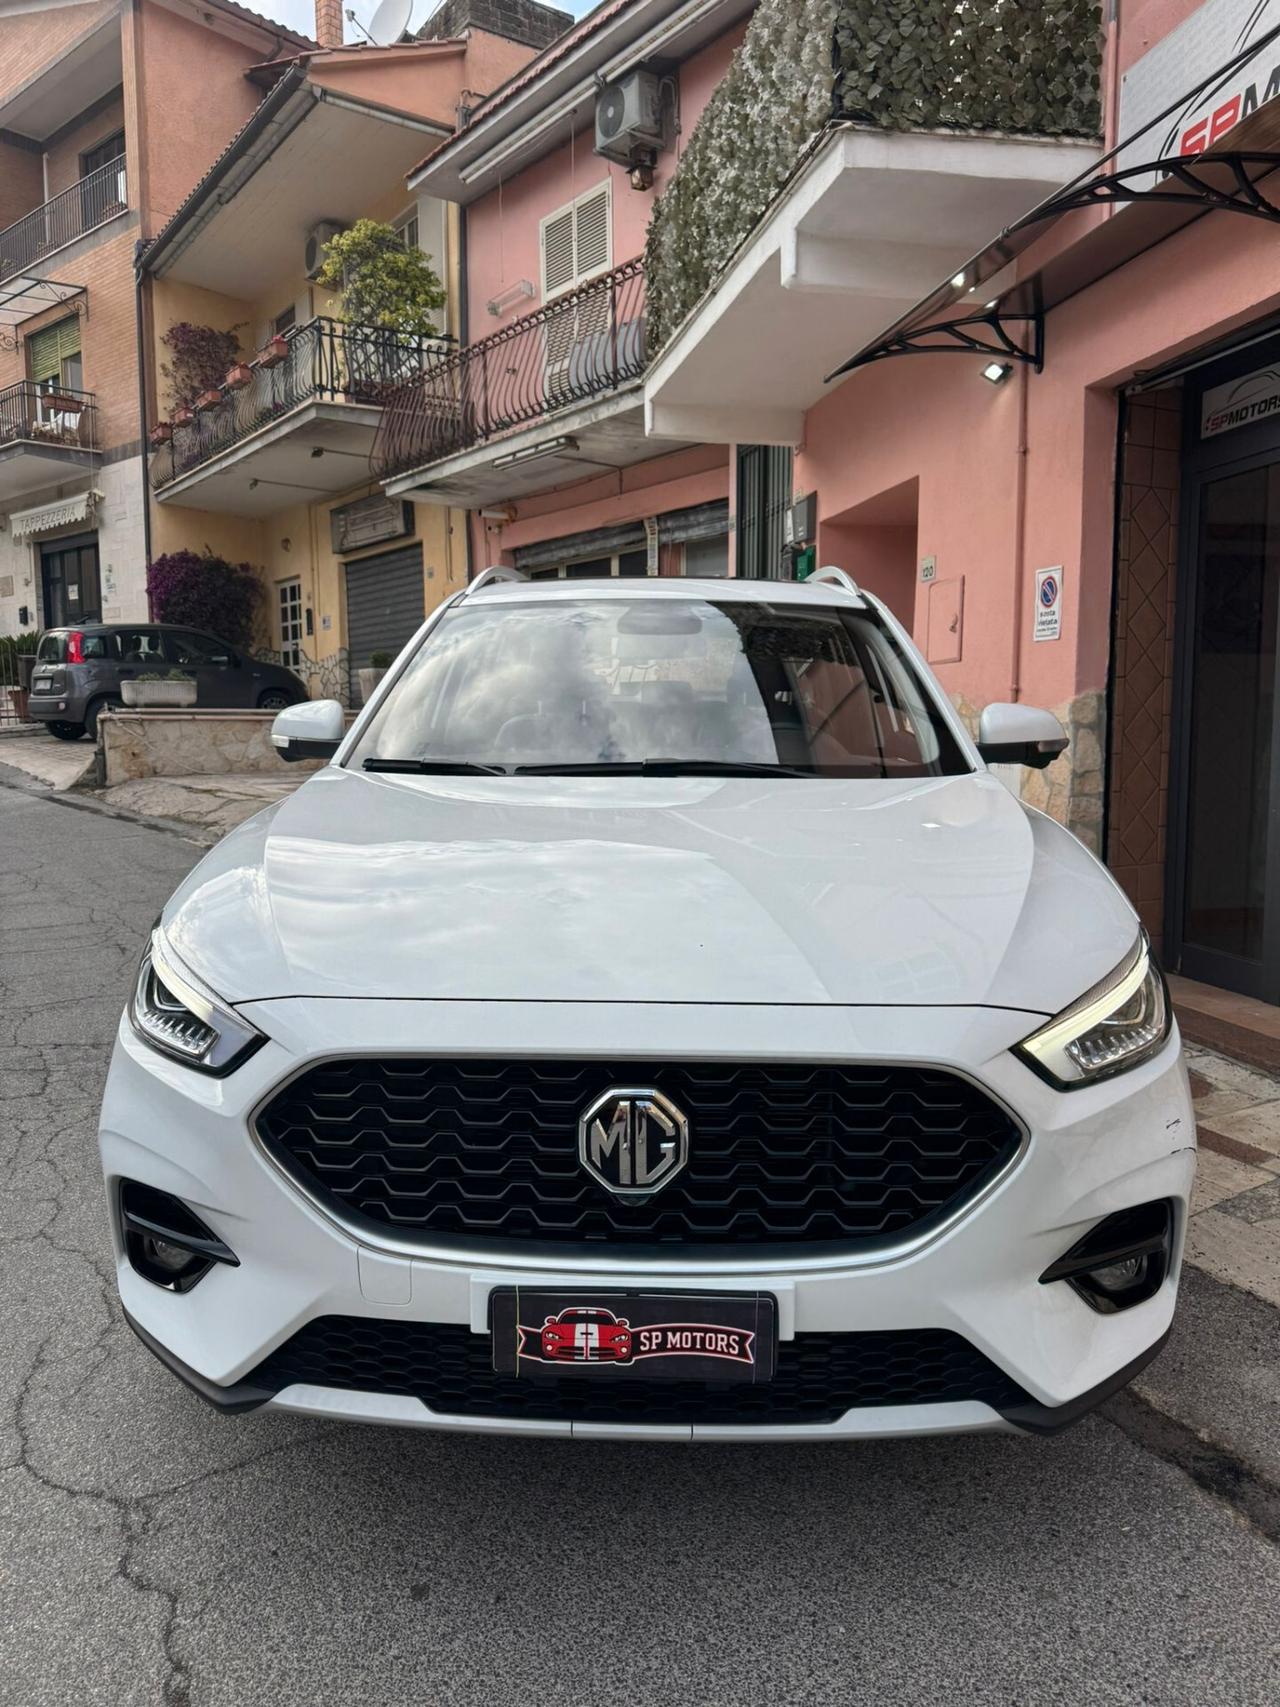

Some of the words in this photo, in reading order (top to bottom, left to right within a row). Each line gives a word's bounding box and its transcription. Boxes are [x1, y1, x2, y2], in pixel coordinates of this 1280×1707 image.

[20, 506, 76, 529] TAPPEZZERIA
[590, 1100, 676, 1185] MG
[639, 1331, 662, 1351] SP
[667, 1331, 739, 1355] MOTORS
